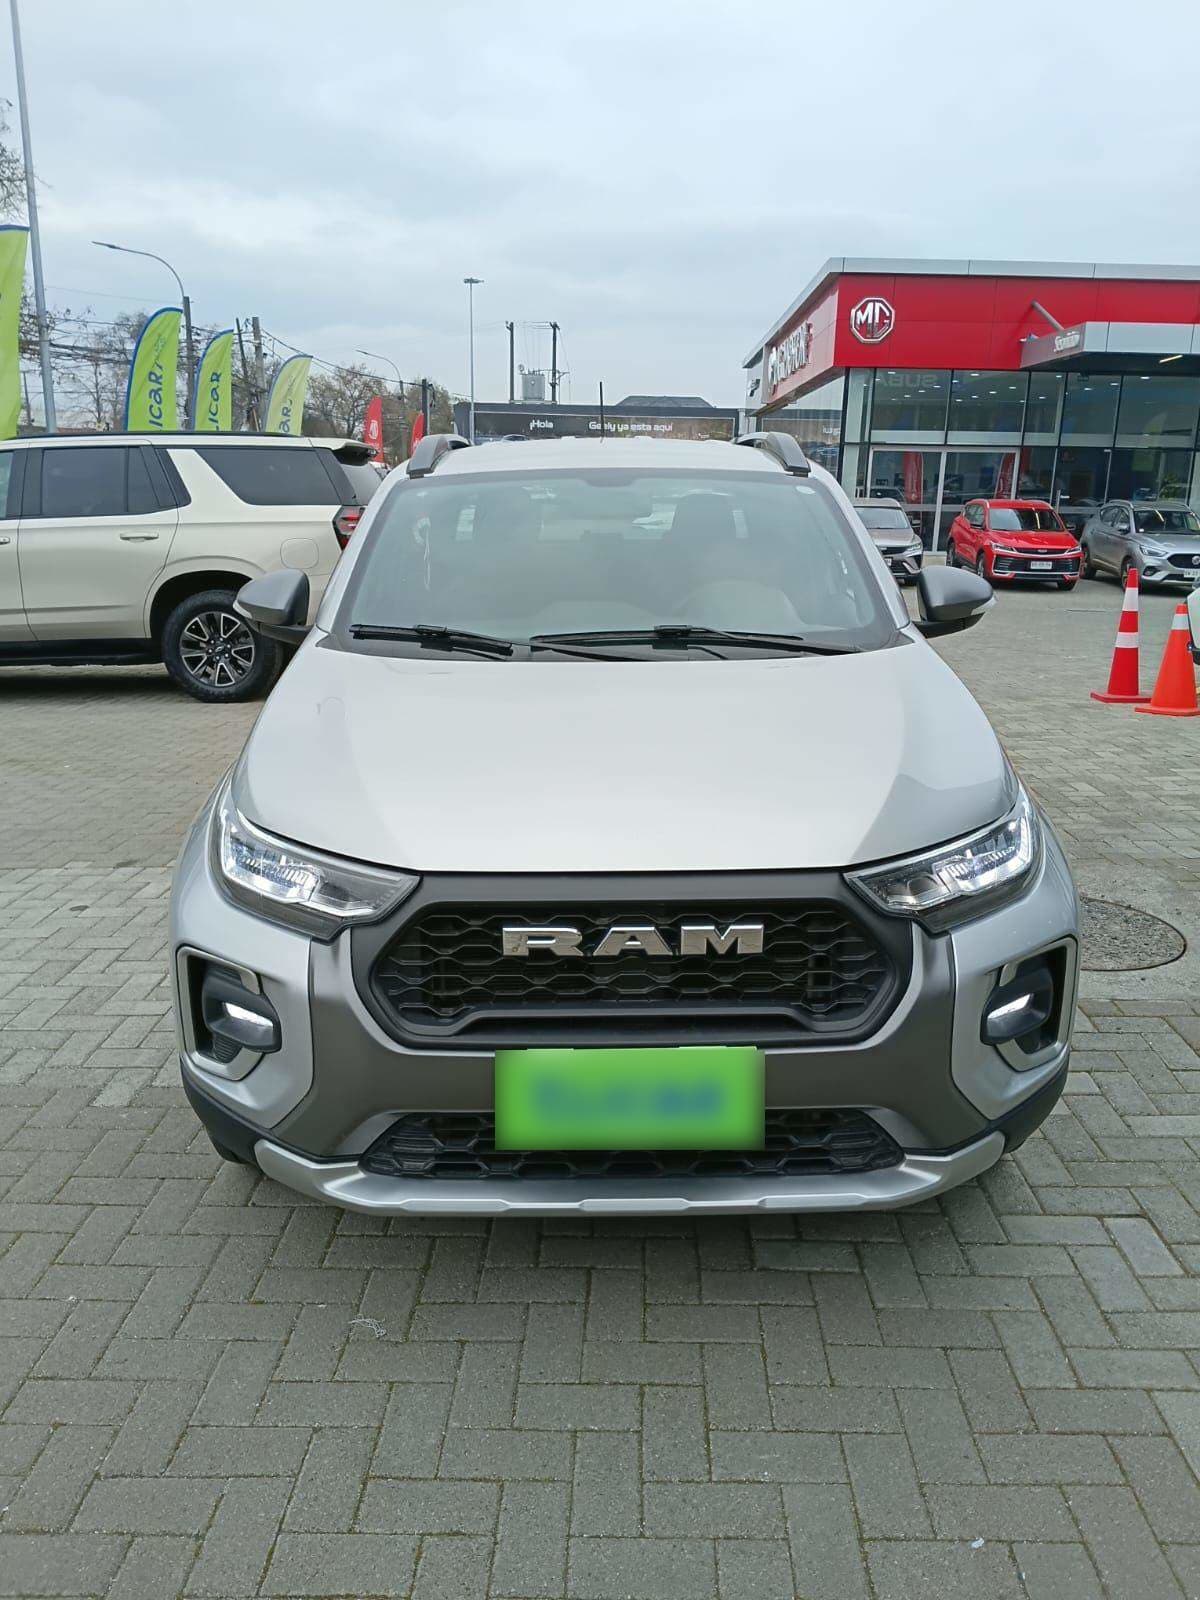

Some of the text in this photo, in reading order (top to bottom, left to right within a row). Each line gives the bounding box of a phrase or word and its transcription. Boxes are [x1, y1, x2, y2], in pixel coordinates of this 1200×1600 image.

[855, 301, 891, 339] MG
[617, 423, 629, 432] ya
[502, 925, 764, 956] RAM
